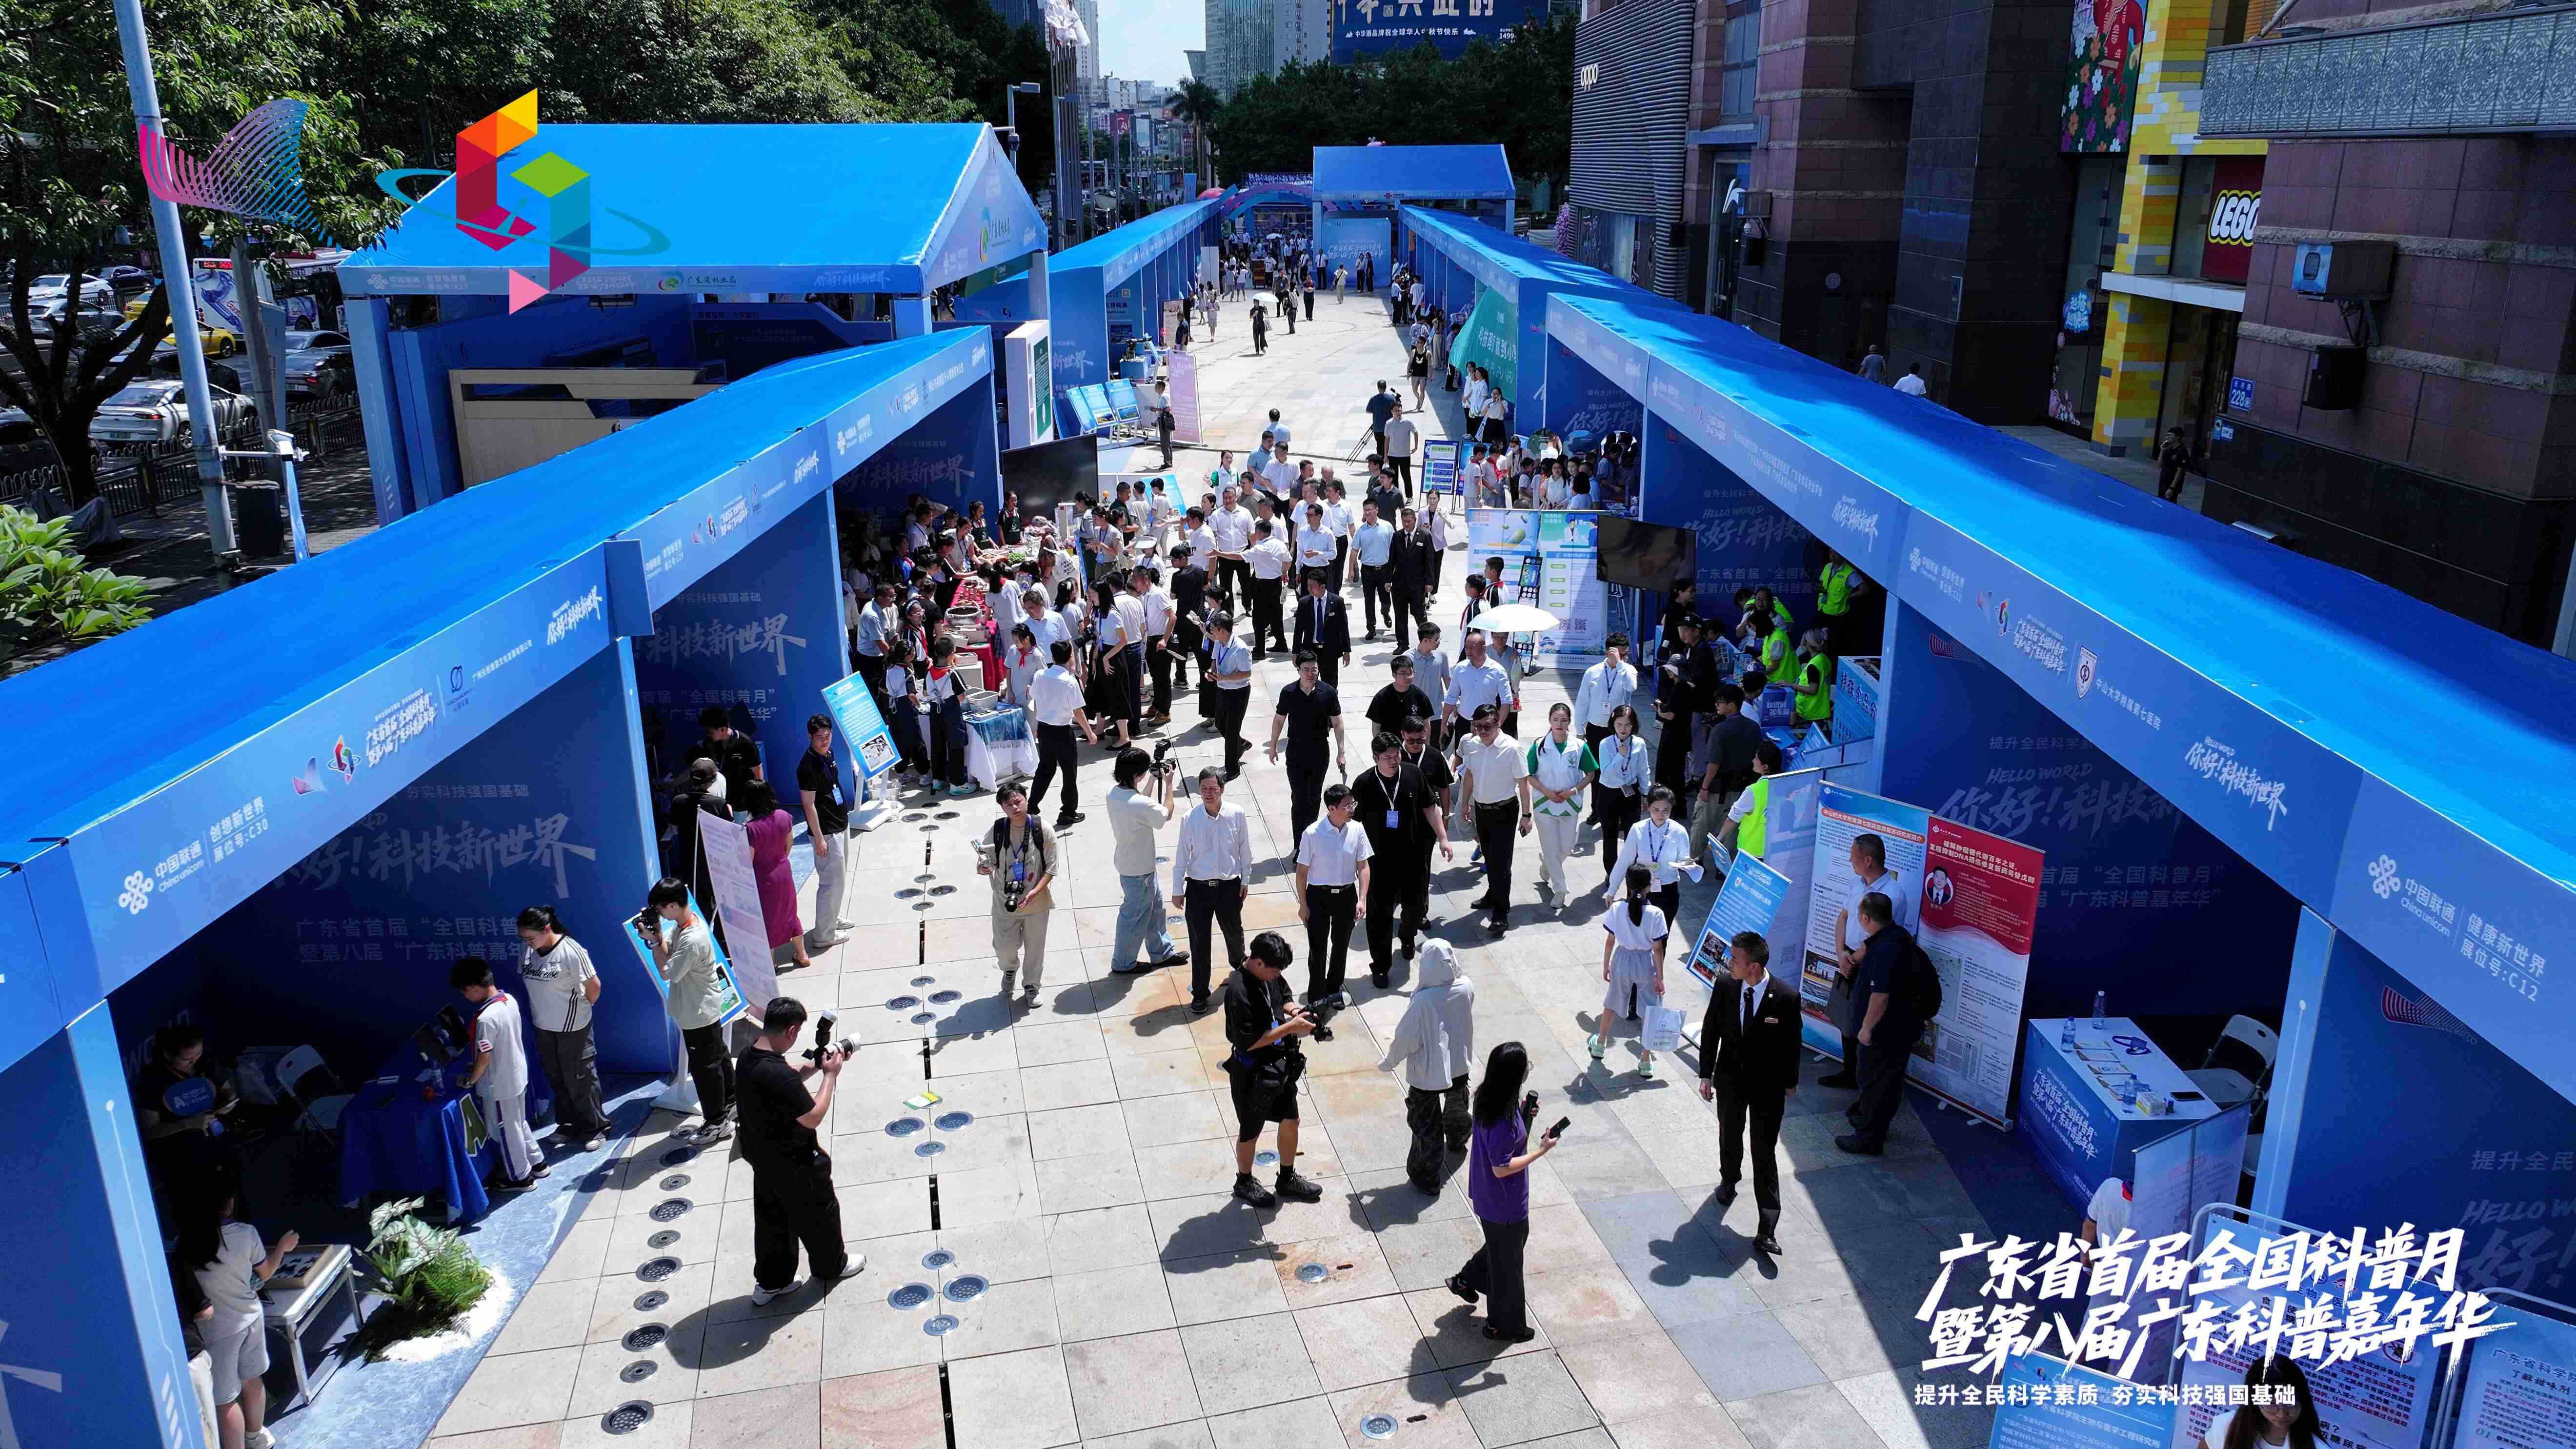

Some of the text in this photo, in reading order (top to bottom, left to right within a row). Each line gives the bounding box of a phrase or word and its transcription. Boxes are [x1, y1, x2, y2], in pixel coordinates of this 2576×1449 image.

[1580, 63, 1599, 90] oppo
[2211, 197, 2259, 239] LEGO
[687, 276, 737, 284] 广东省林业局
[2230, 389, 2245, 407] 228
[2096, 677, 2163, 730] 中山大学附属第七医院
[407, 784, 530, 799] 夯实科技强国基础
[1987, 763, 2093, 785] HELLO WORLD
[2185, 741, 2288, 832] 你好！科技新世界
[210, 796, 264, 843] 创想新世界
[154, 840, 203, 880] 中国联通
[213, 819, 269, 864] 展位号:C30
[274, 812, 596, 899] 好！科技新世界
[2404, 878, 2456, 925] 中国联通
[2468, 913, 2546, 978] 健康新世界
[2459, 938, 2538, 1004] 展位号:C12
[2471, 1150, 2576, 1172] 提升全民
